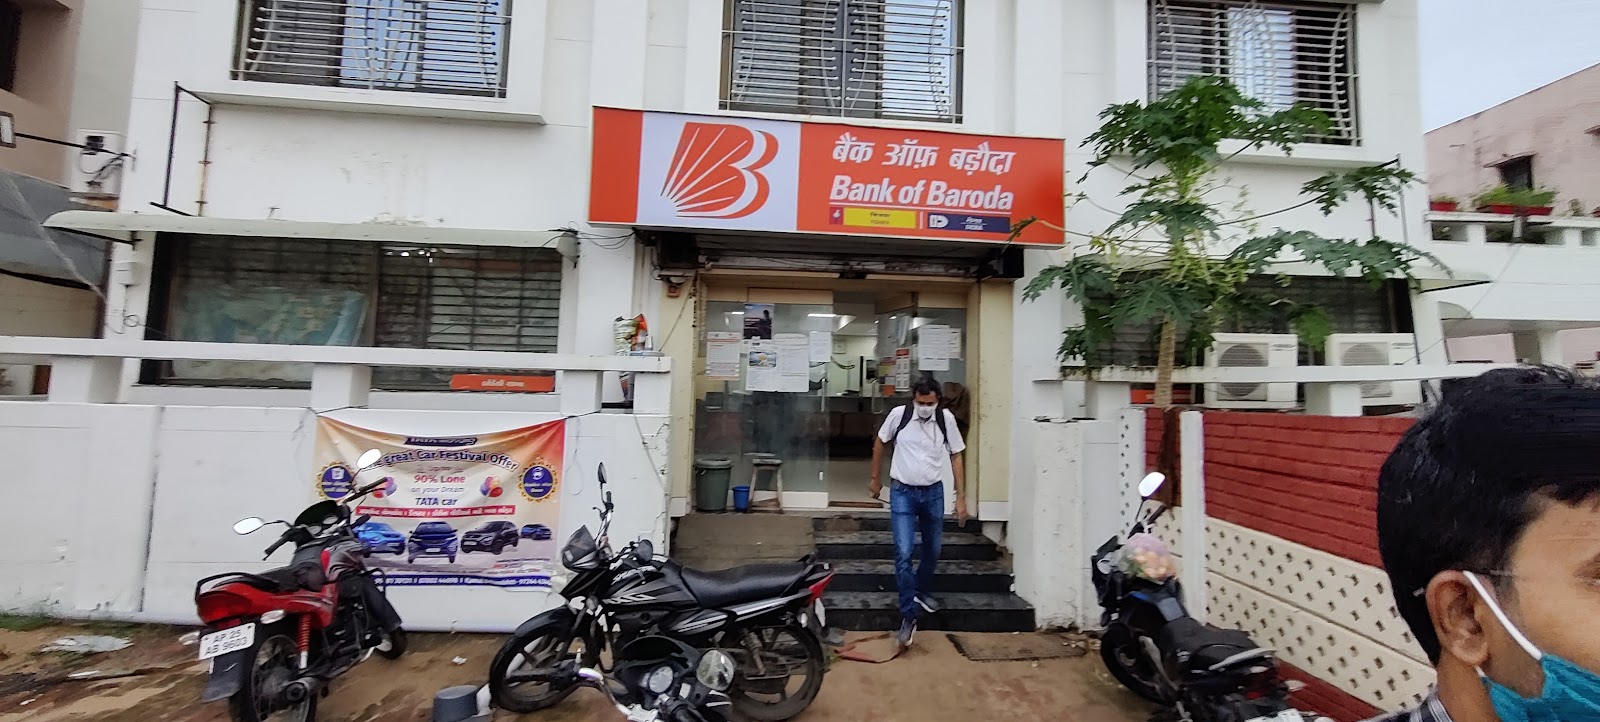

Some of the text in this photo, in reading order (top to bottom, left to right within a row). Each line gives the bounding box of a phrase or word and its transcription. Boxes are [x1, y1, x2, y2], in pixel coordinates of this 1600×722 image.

[832, 131, 876, 164] बैंक
[829, 174, 1015, 211] Bank of Baroda
[417, 450, 437, 460] Car
[439, 450, 486, 462] Festival
[490, 454, 518, 471] Offer
[414, 474, 466, 484] 90% Lone
[421, 486, 440, 495] your
[415, 497, 458, 506] TATA car
[213, 629, 242, 643] AP 25
[204, 644, 219, 655] AB
